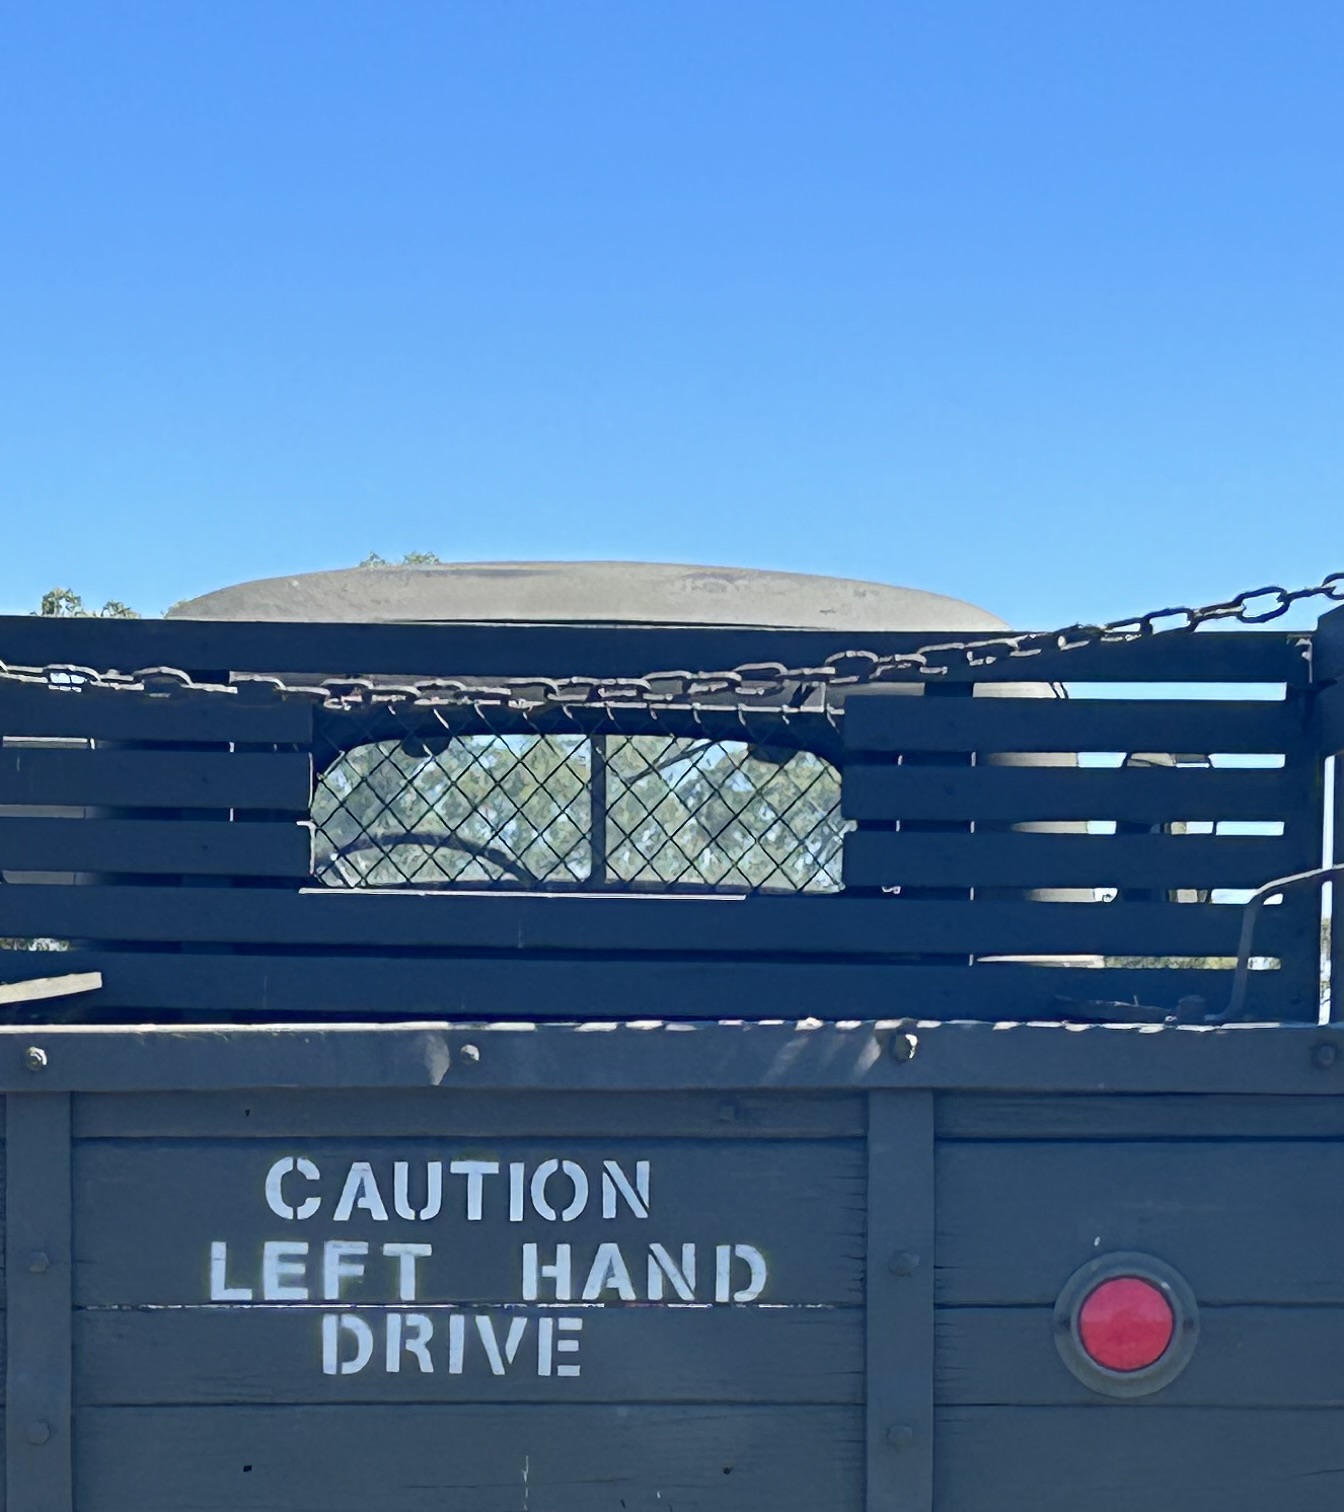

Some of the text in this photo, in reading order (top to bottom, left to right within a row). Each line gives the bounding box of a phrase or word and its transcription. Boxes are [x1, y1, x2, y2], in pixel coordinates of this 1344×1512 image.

[265, 1156, 650, 1222] CAUTION
[210, 1239, 767, 1303] LEFT HAND
[321, 1312, 583, 1377] DRIVE
